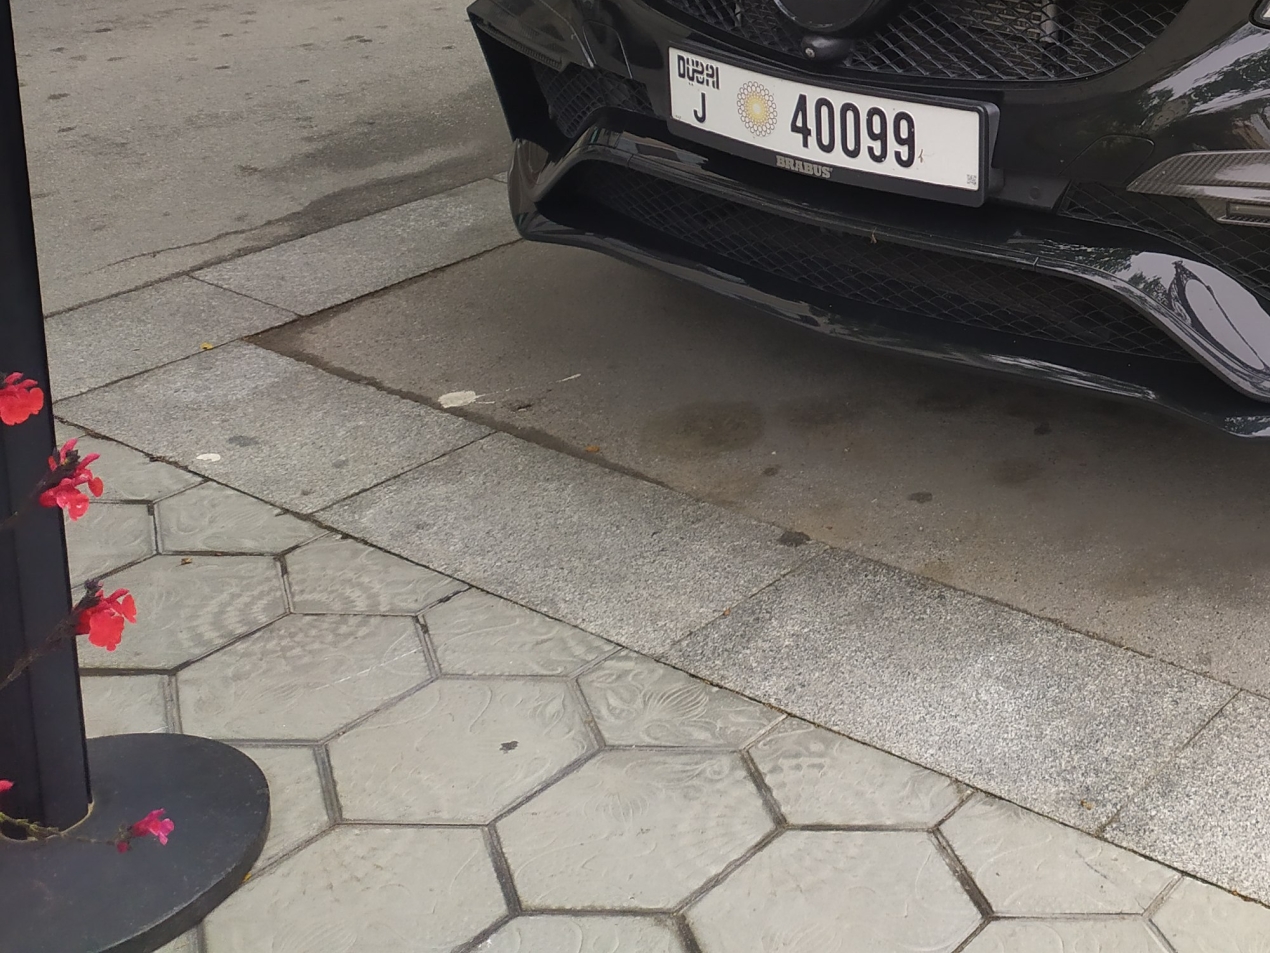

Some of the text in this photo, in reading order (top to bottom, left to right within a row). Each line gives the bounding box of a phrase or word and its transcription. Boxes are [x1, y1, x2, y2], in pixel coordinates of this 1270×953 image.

[693, 92, 706, 123] J
[790, 93, 916, 168] 40099
[776, 155, 831, 179] BRABUS
